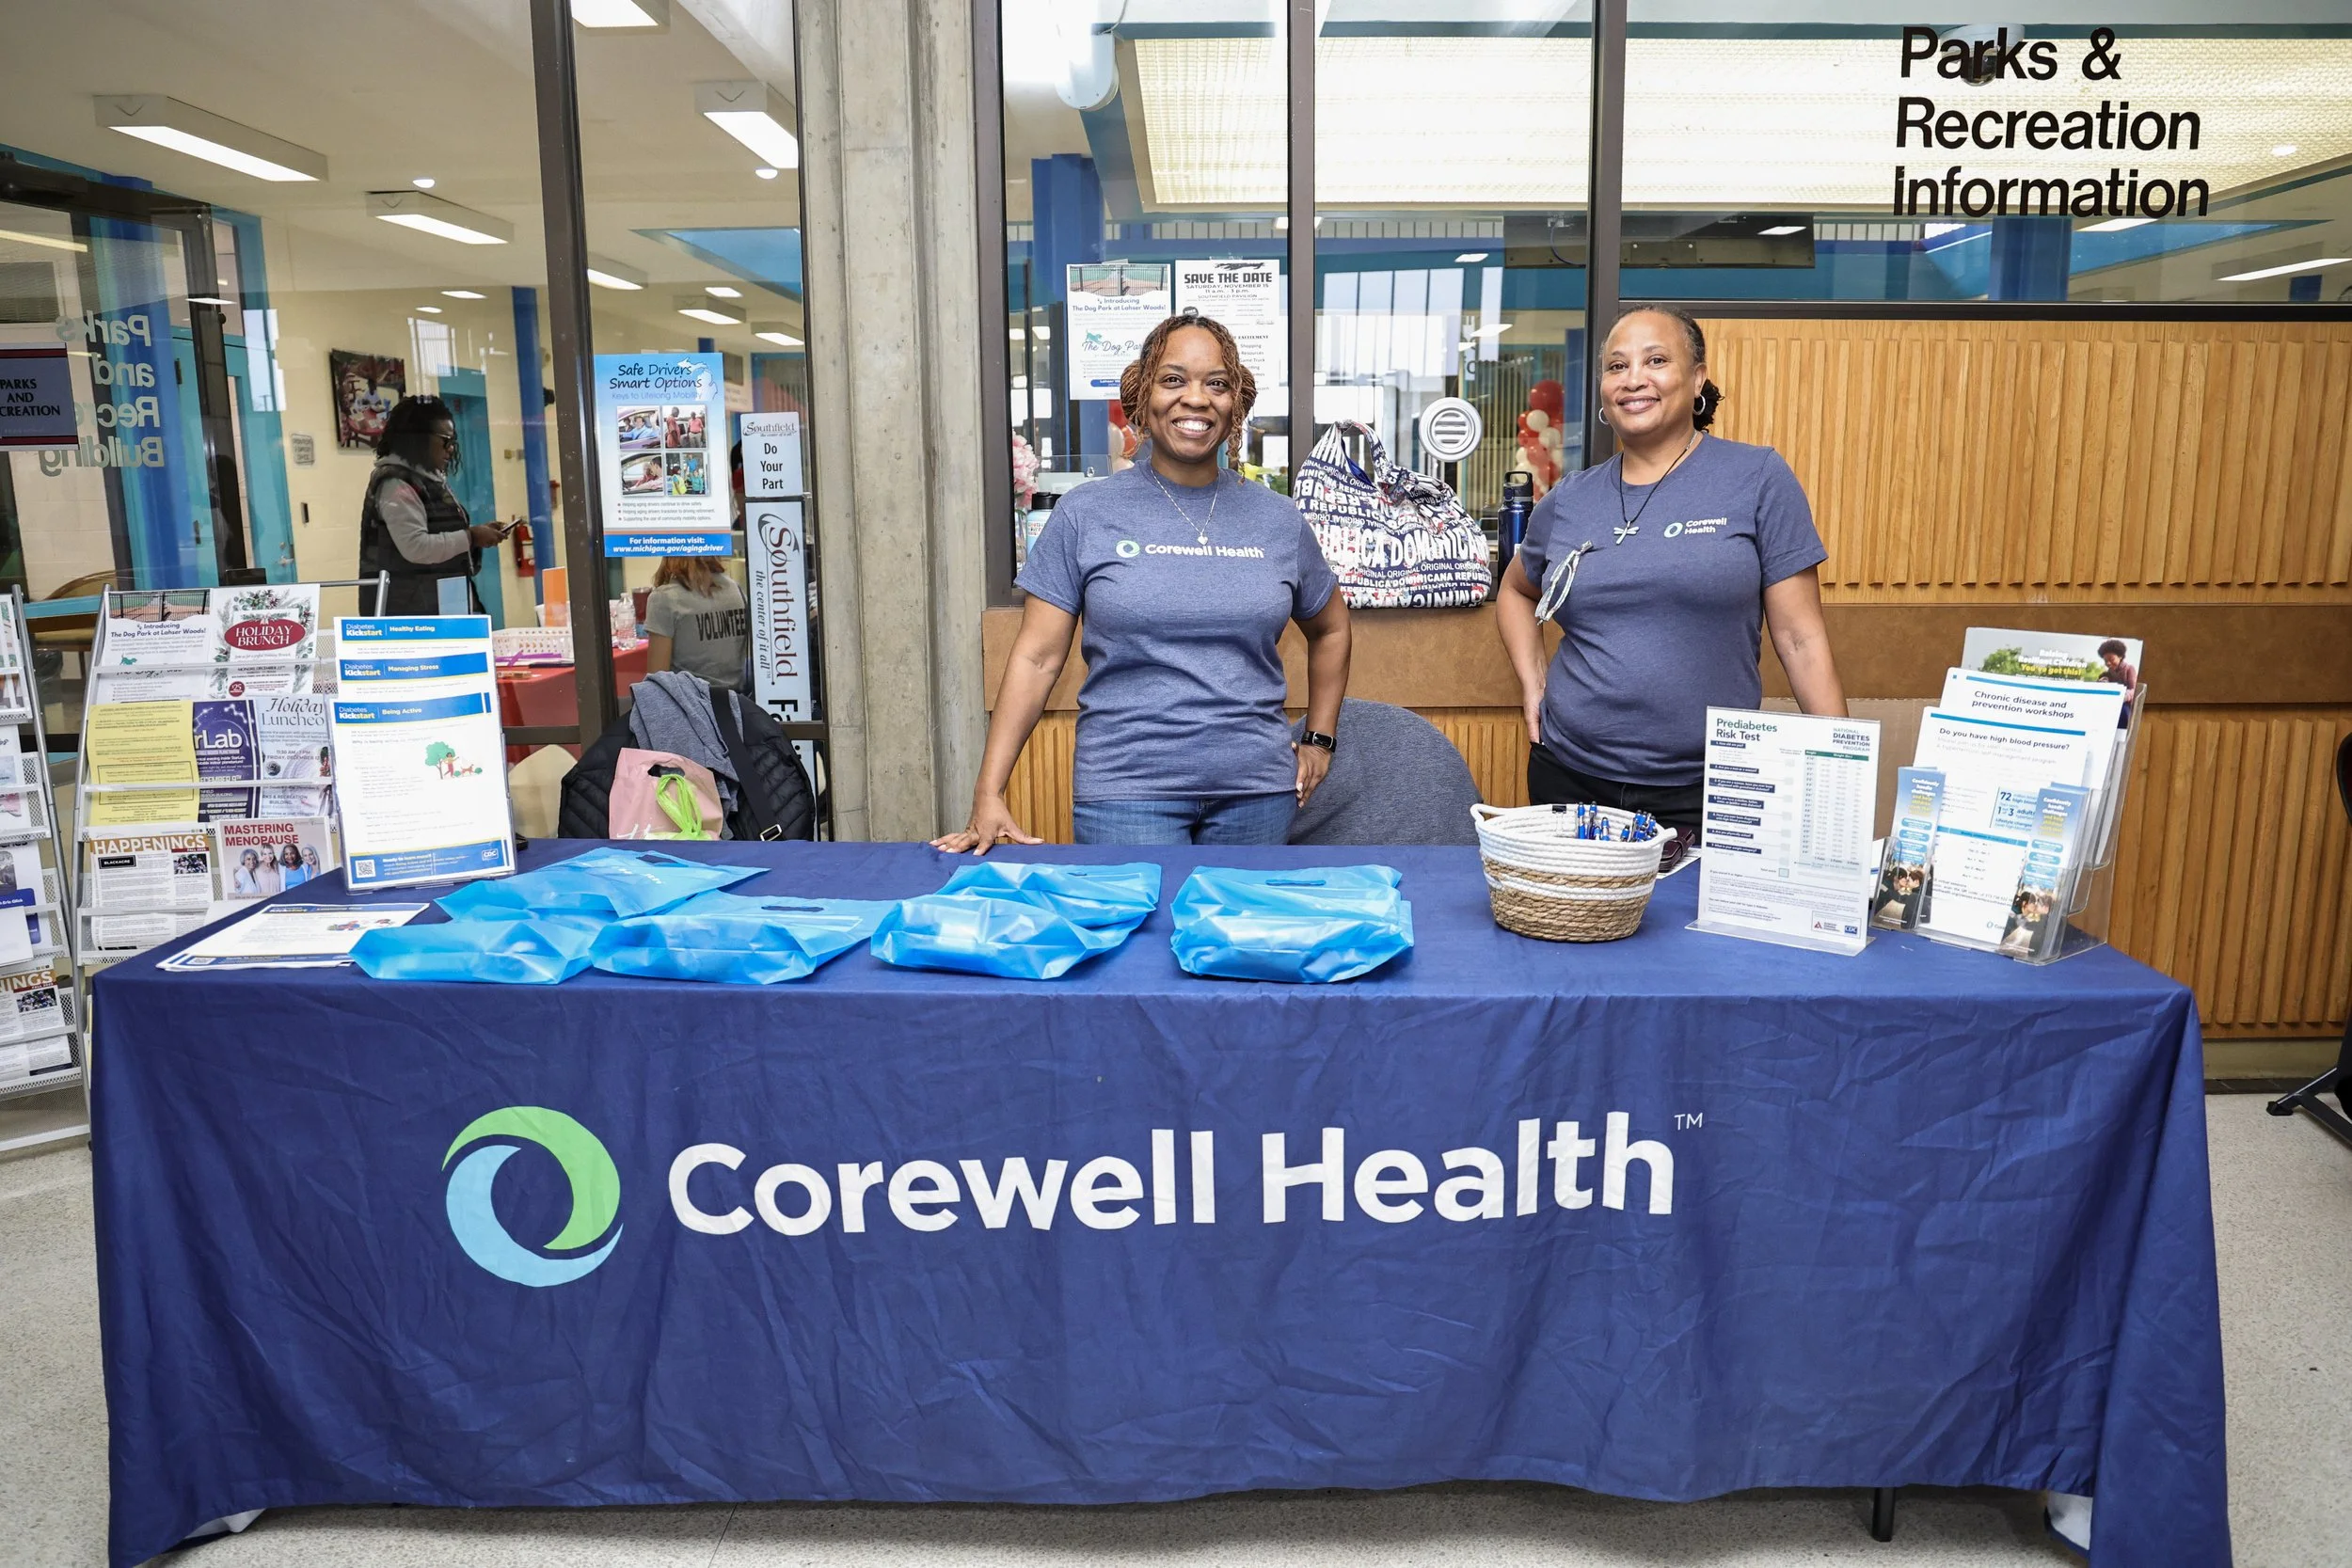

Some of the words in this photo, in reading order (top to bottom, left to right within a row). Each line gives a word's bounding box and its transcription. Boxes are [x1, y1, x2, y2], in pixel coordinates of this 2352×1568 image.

[1900, 26, 2058, 80] Parks
[2082, 27, 2122, 80] &
[1897, 97, 2201, 150] Recreation
[1892, 166, 2209, 217] Information
[1184, 274, 1214, 283] SAVE
[1217, 273, 1239, 283] THE
[1243, 272, 1272, 282] DATE
[1082, 341, 1099, 351] The
[1102, 341, 1121, 355] Dog
[1125, 341, 1142, 351] Par
[618, 363, 644, 376] Safe
[649, 363, 692, 375] Drivers
[0, 378, 37, 389] PARKS
[610, 378, 650, 389] Smart
[655, 376, 702, 392] Options
[7, 392, 34, 403] AND
[0, 405, 61, 417] CREATION
[746, 421, 795, 432] Southfield
[764, 443, 777, 454] Do
[760, 461, 783, 472] Your
[762, 478, 784, 490] Part
[1686, 517, 1727, 527] Corewell
[1684, 526, 1716, 535] Health
[612, 545, 724, 554] www.michigan.gov/agingdriver
[1145, 544, 1213, 556] Corewell
[1216, 546, 1263, 559] Health
[1421, 562, 1454, 572] ORIGINAL
[755, 570, 765, 588] the
[770, 526, 798, 678] Southfield
[756, 592, 768, 626] center
[695, 608, 747, 641] VOLUNTEE
[236, 626, 293, 637] HOLIDAY
[756, 629, 769, 641] of
[238, 635, 290, 647] BRUNCH
[759, 643, 770, 652] it
[760, 655, 770, 670] all
[2021, 664, 2047, 673] You've
[2048, 667, 2062, 676] got
[1974, 690, 2010, 703] Chronic
[2012, 696, 2047, 707] disease
[2049, 700, 2067, 708] and
[265, 697, 323, 715] Holiday
[1972, 700, 2022, 714] prevention
[2025, 706, 2074, 719] workshops
[262, 713, 325, 726] Luncheo
[1716, 718, 1777, 733] Prediabetes
[194, 729, 243, 749] rLab
[1716, 729, 1737, 739] Risk
[1740, 731, 1760, 742] Test
[1833, 733, 1869, 741] DIABETES
[1990, 735, 2008, 743] high
[2033, 741, 2070, 750] pressure?
[2000, 792, 2011, 801] 72
[1997, 806, 2002, 815] 1
[2008, 808, 2014, 816] 3
[224, 823, 294, 835] MASTERING
[93, 835, 207, 854] HAPPENINGS
[225, 834, 299, 847] MENOPAUSE
[668, 1129, 1216, 1235] Corewell
[1263, 1111, 1674, 1223] Health
